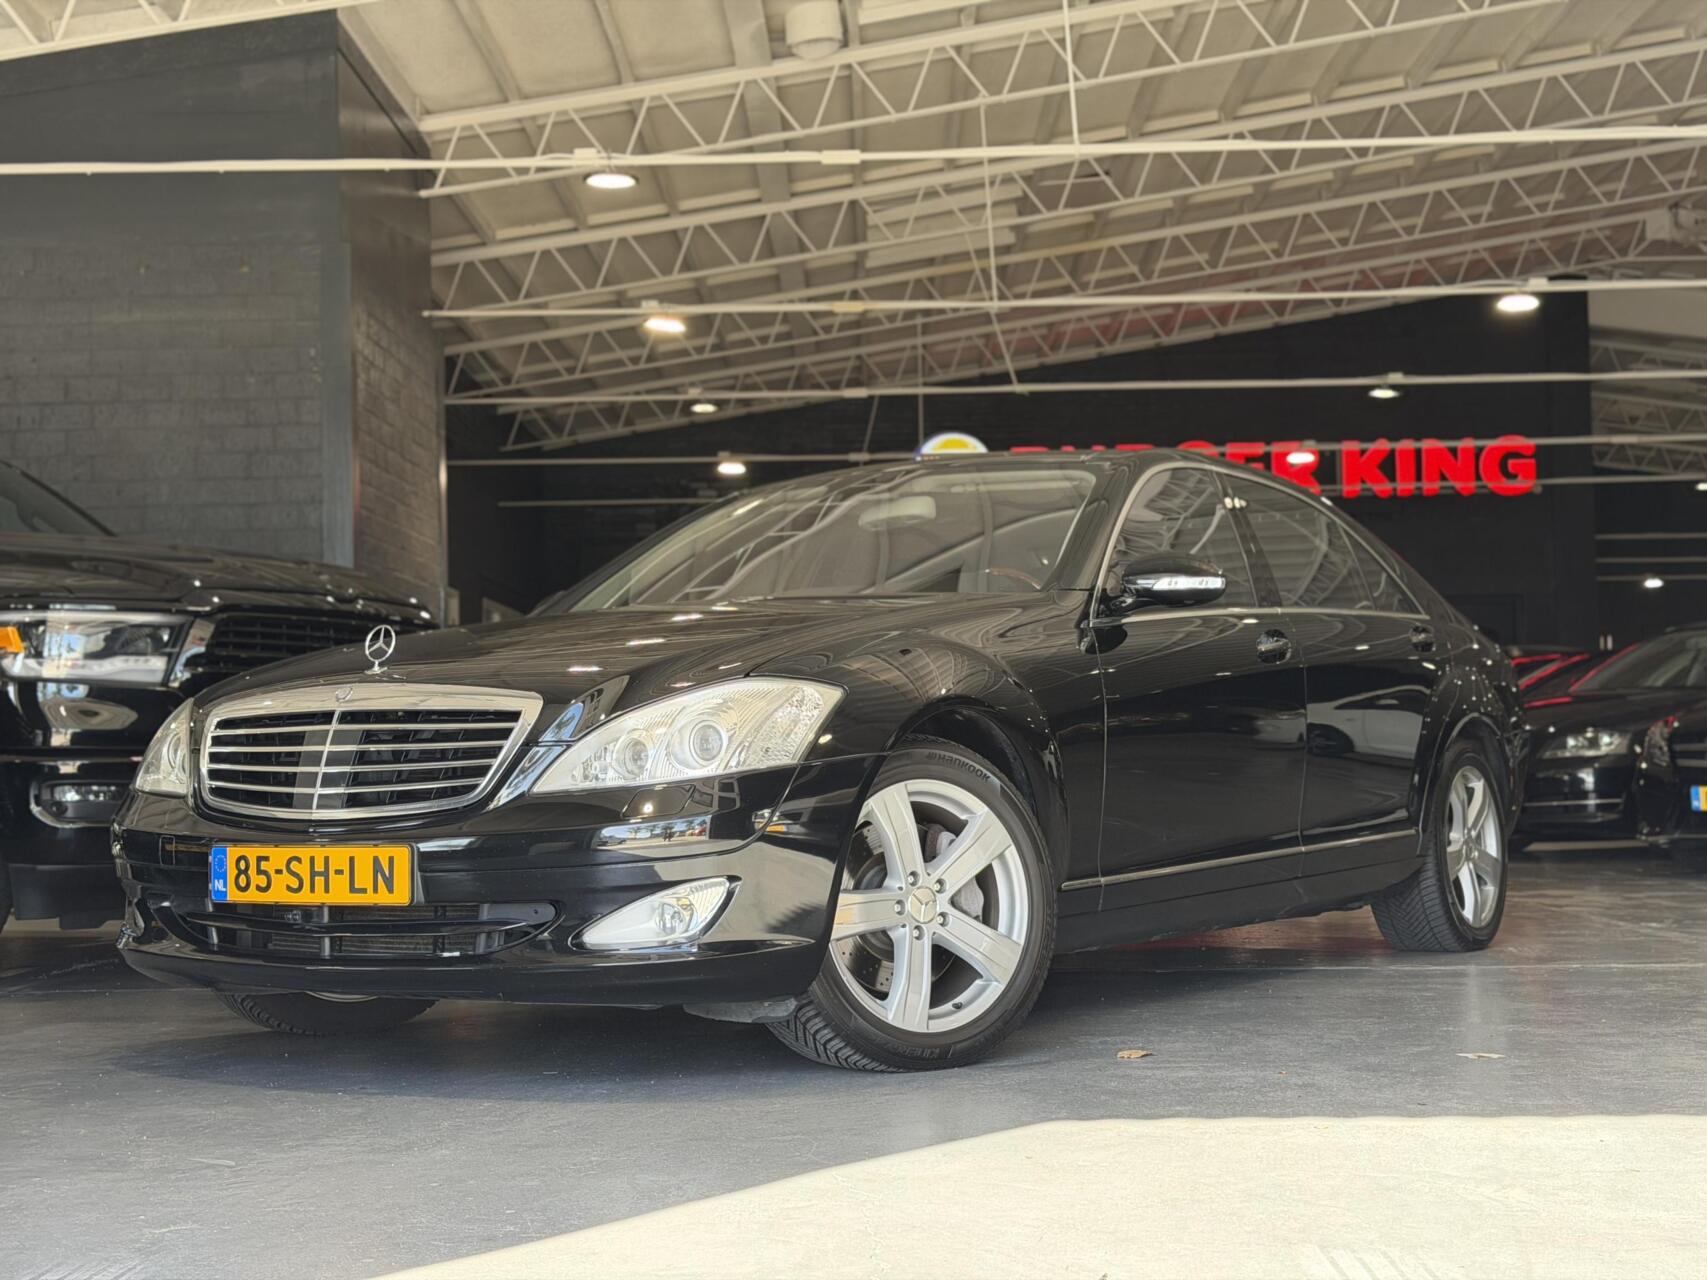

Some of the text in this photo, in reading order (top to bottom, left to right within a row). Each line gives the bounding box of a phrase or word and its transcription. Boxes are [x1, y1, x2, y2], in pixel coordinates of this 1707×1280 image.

[1341, 434, 1537, 498] KING
[214, 879, 227, 891] NL
[234, 855, 395, 894] 85-SH-LN
